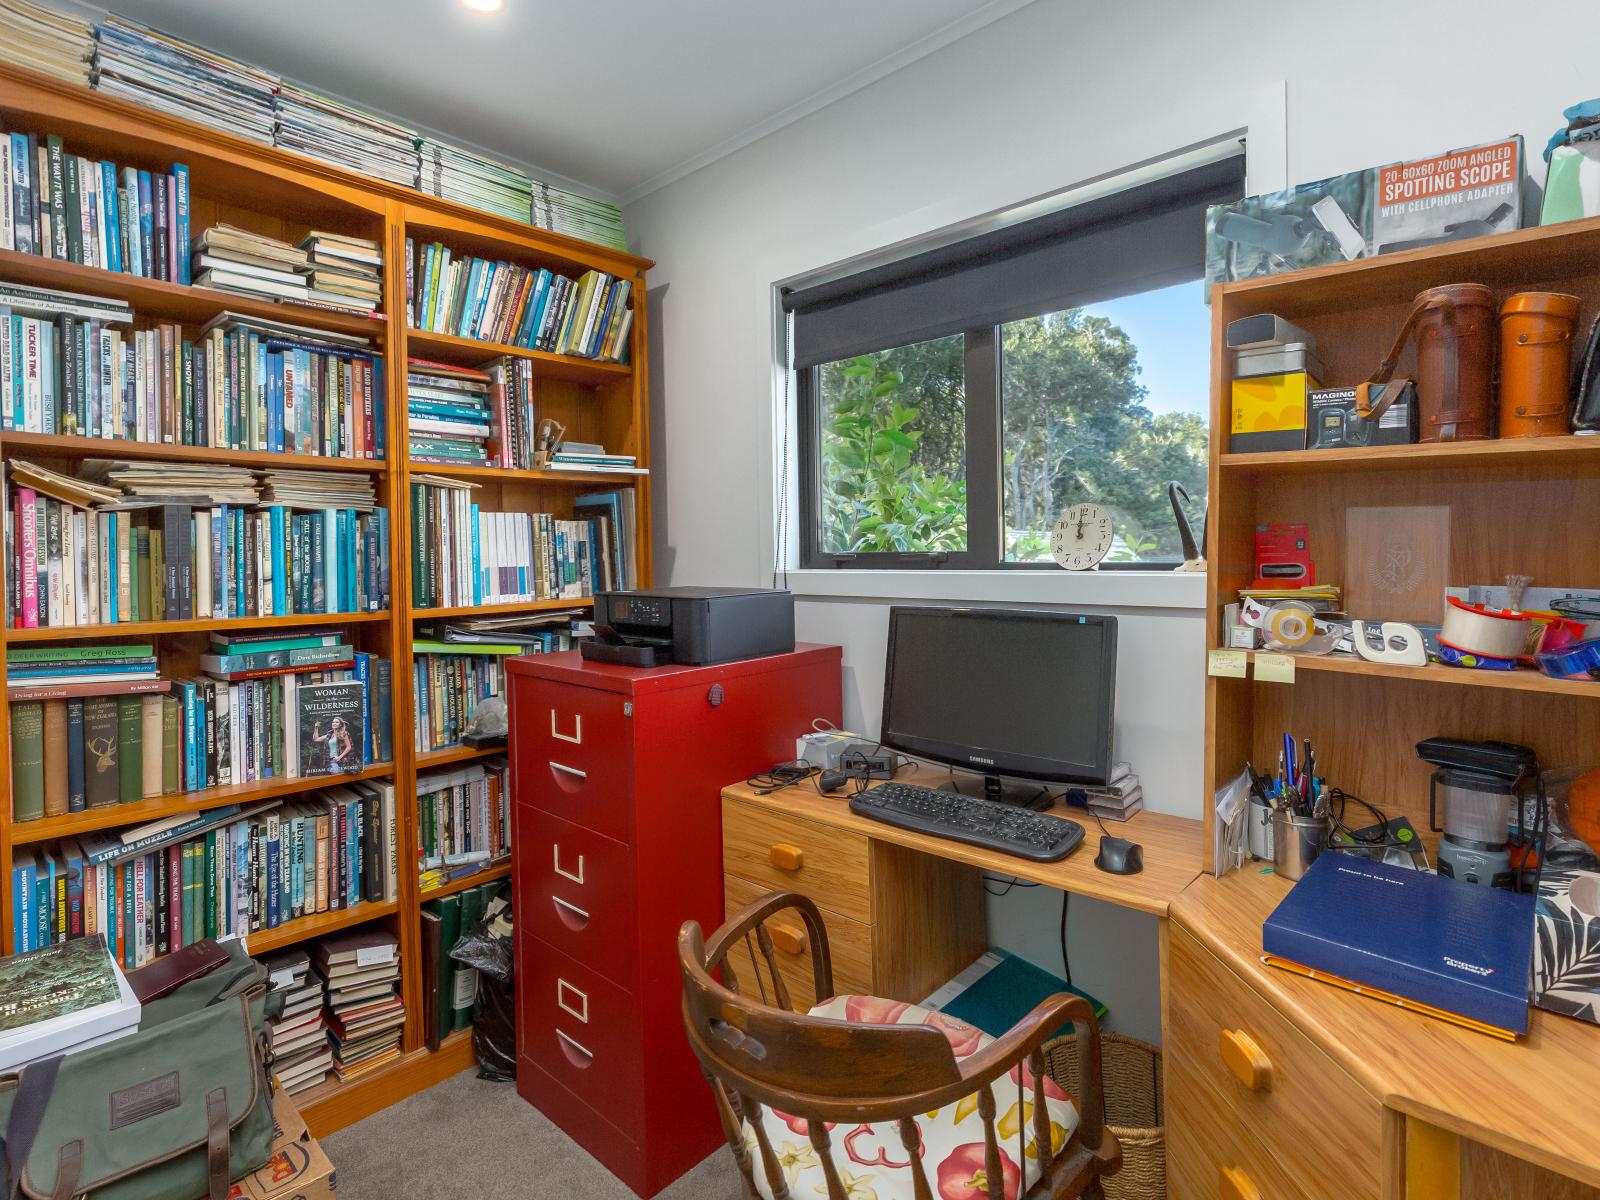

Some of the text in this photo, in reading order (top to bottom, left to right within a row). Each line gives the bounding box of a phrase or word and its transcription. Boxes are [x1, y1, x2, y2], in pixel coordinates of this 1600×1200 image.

[52, 146, 60, 160] THE
[1438, 156, 1466, 172] ZOOM
[1470, 147, 1510, 166] ANGLED
[1386, 160, 1510, 201] SPOTTING SCOPE
[55, 191, 63, 208] WAS
[1382, 183, 1513, 217] WITH CELLPHONE ADAPTER
[11, 290, 48, 300] Accidental
[1312, 391, 1356, 399] MAGINO
[45, 413, 53, 434] YARNS
[1070, 511, 1075, 520] 11
[1093, 509, 1097, 518] 1
[1060, 521, 1068, 530] 10
[1099, 519, 1106, 527] 2
[1100, 530, 1106, 539] 3
[1056, 545, 1063, 553] 8
[1095, 544, 1101, 552] 4
[1065, 554, 1071, 563] 7
[1074, 556, 1080, 566] 6
[1087, 553, 1093, 562] 5
[25, 550, 36, 597] Omnibus
[38, 585, 46, 598] JOHN
[305, 701, 359, 710] WILDERNESS
[970, 756, 994, 764] SAMSUNG
[98, 830, 173, 862] LIFE ON MUZZLE
[269, 864, 278, 873] Eye
[38, 905, 47, 932] MOOSE
[58, 902, 66, 932] ADVENTURES
[1443, 956, 1489, 973] Property
[1446, 960, 1487, 976] Brokers
